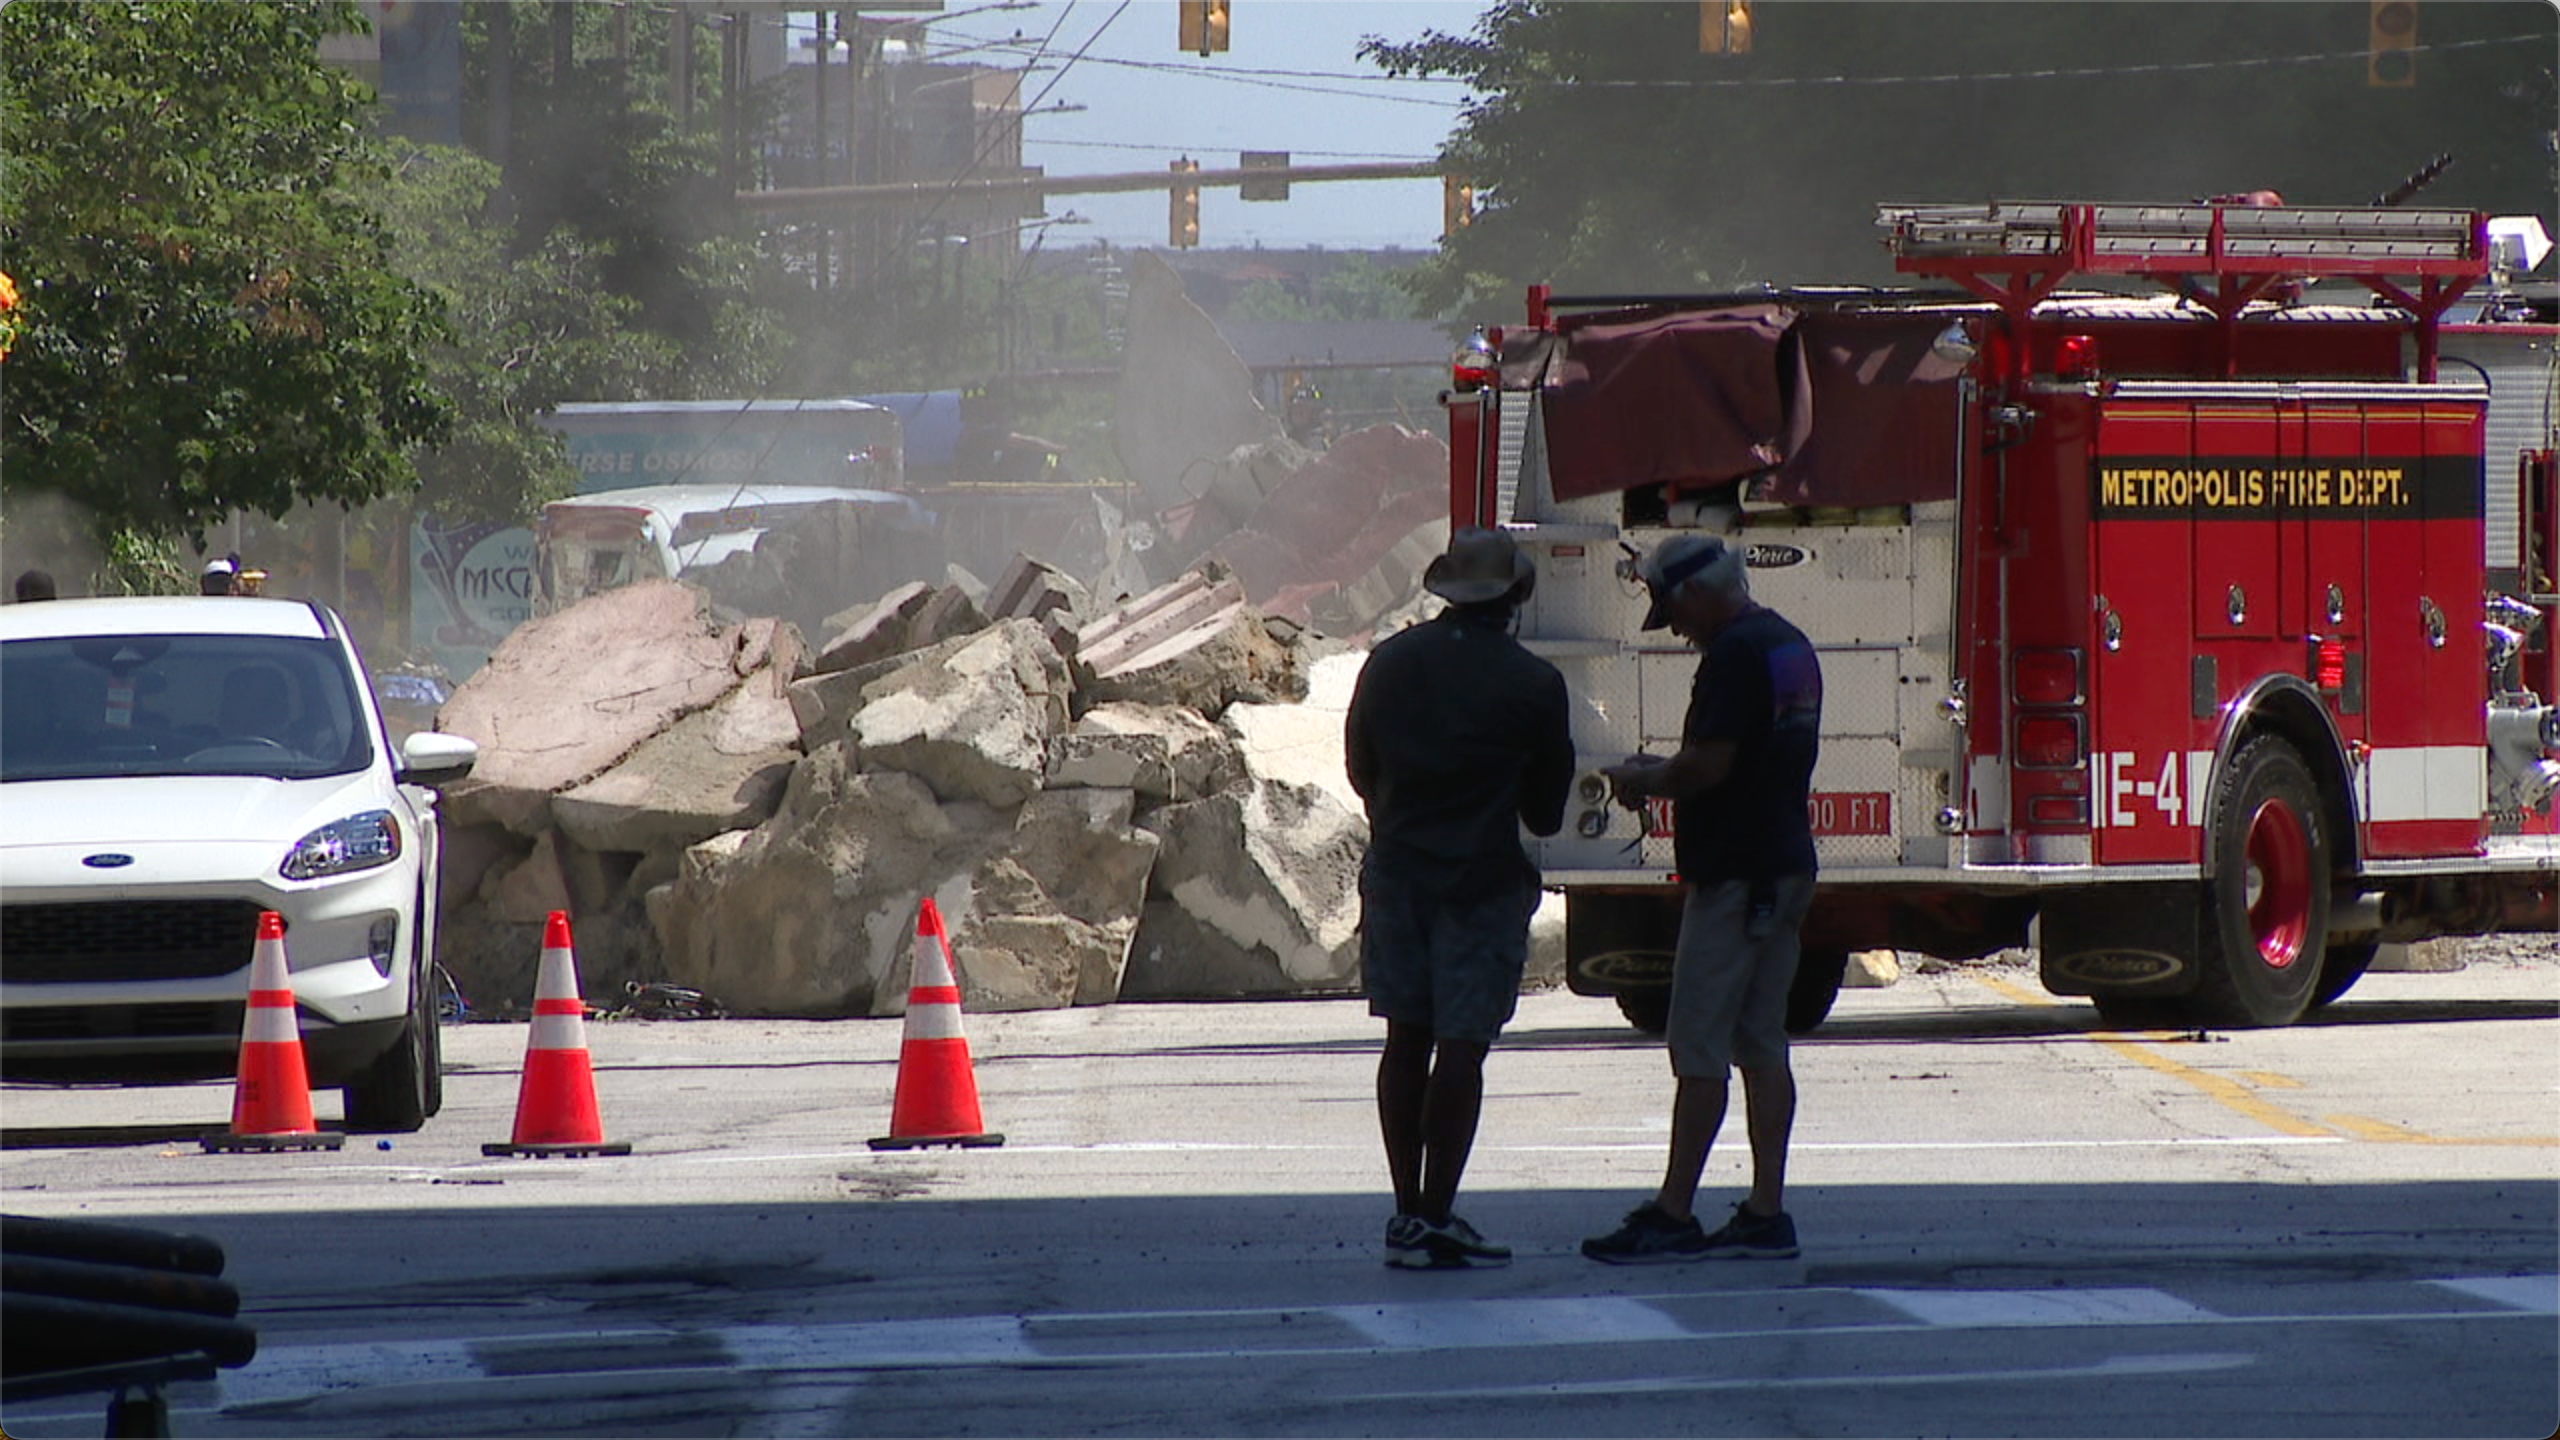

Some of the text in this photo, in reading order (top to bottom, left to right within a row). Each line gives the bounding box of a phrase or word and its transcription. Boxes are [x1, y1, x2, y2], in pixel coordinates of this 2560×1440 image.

[2101, 469, 2409, 507] METROPOLIS FIRE DEPT.
[1851, 798, 1882, 830] FT.
